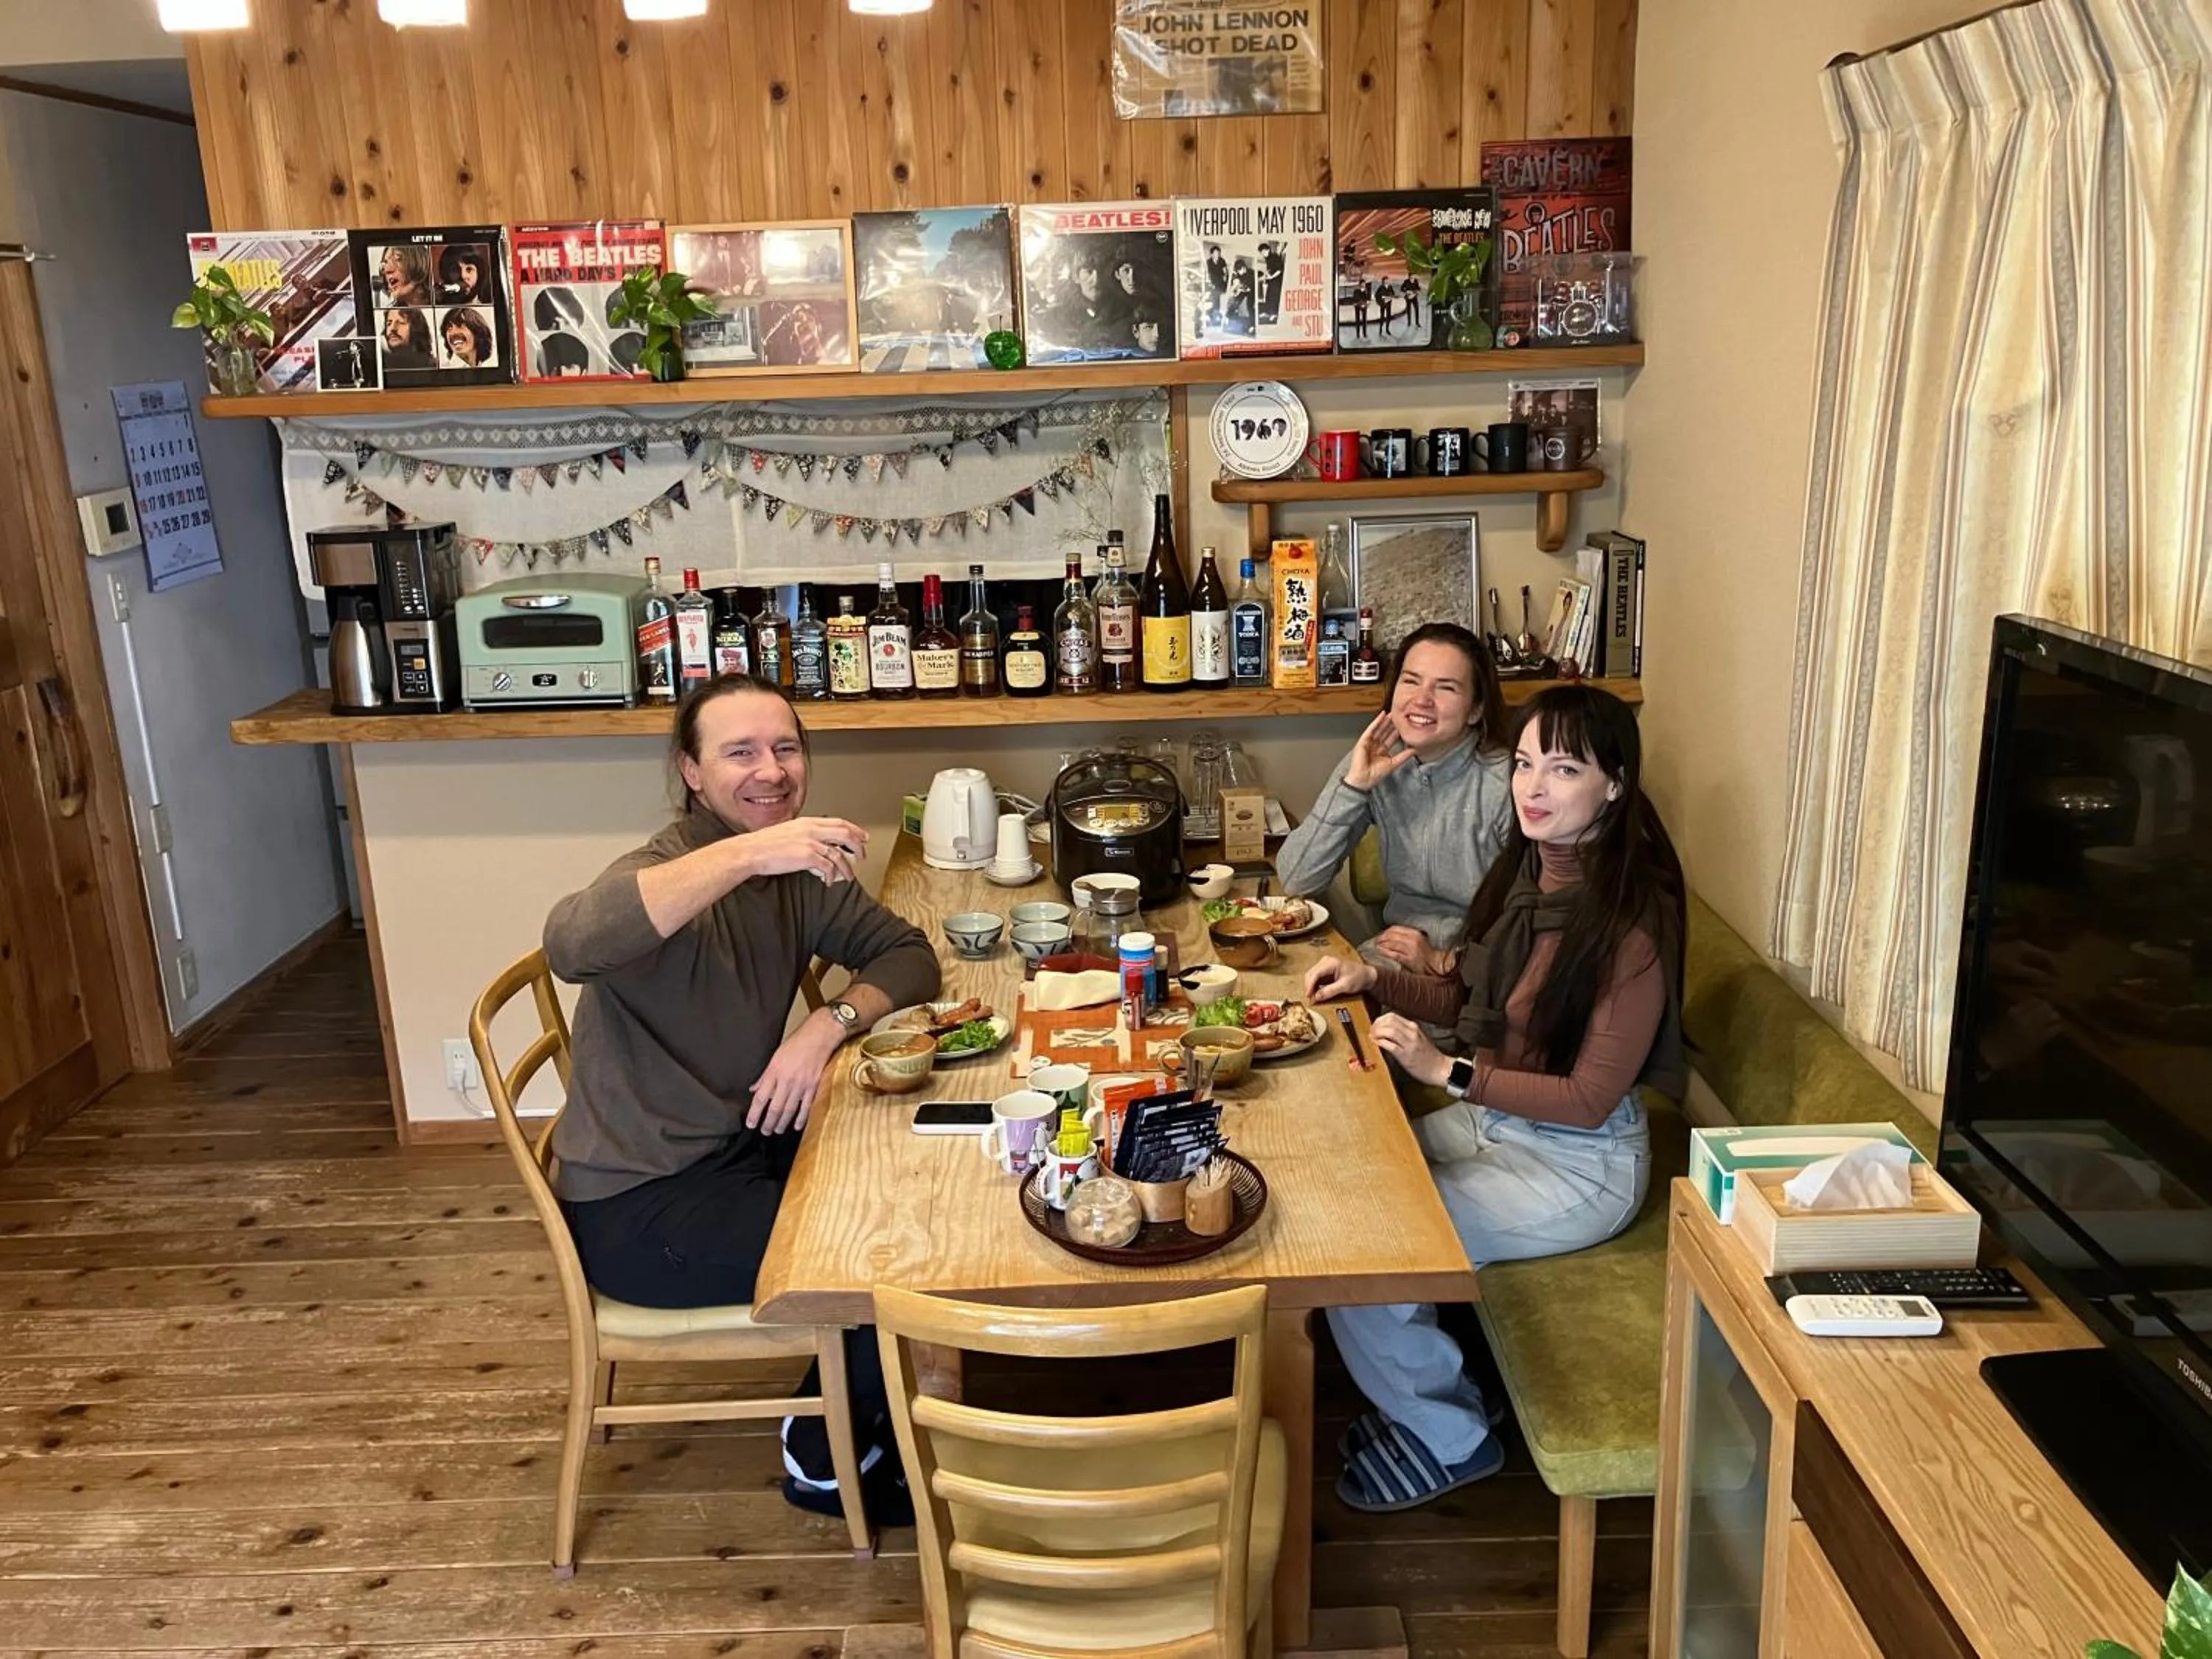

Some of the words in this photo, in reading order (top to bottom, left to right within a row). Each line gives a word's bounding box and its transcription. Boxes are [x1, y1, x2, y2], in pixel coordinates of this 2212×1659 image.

[1142, 13, 1203, 34] JOHN
[1213, 10, 1309, 31] LENNON
[1155, 36, 1220, 55] SHOT
[1231, 34, 1298, 53] DEAD
[1503, 152, 1601, 188] CAVERN
[1054, 212, 1171, 229] BEATLES!
[1257, 206, 1287, 234] MAY
[1292, 205, 1324, 233] 1960
[1299, 237, 1324, 260] JOHN
[1503, 204, 1615, 274] BEATLES
[518, 248, 560, 268] THE
[568, 245, 662, 265] BEATLES
[520, 267, 530, 282] A
[577, 265, 616, 282] DAY'S
[1299, 263, 1324, 285] PAUL
[1285, 289, 1324, 311] GEORGE
[1304, 315, 1324, 337] STU
[1617, 557, 1629, 582] THE
[1615, 585, 1629, 638] BEATLES
[2177, 1357, 2212, 1400] TOSHIB
